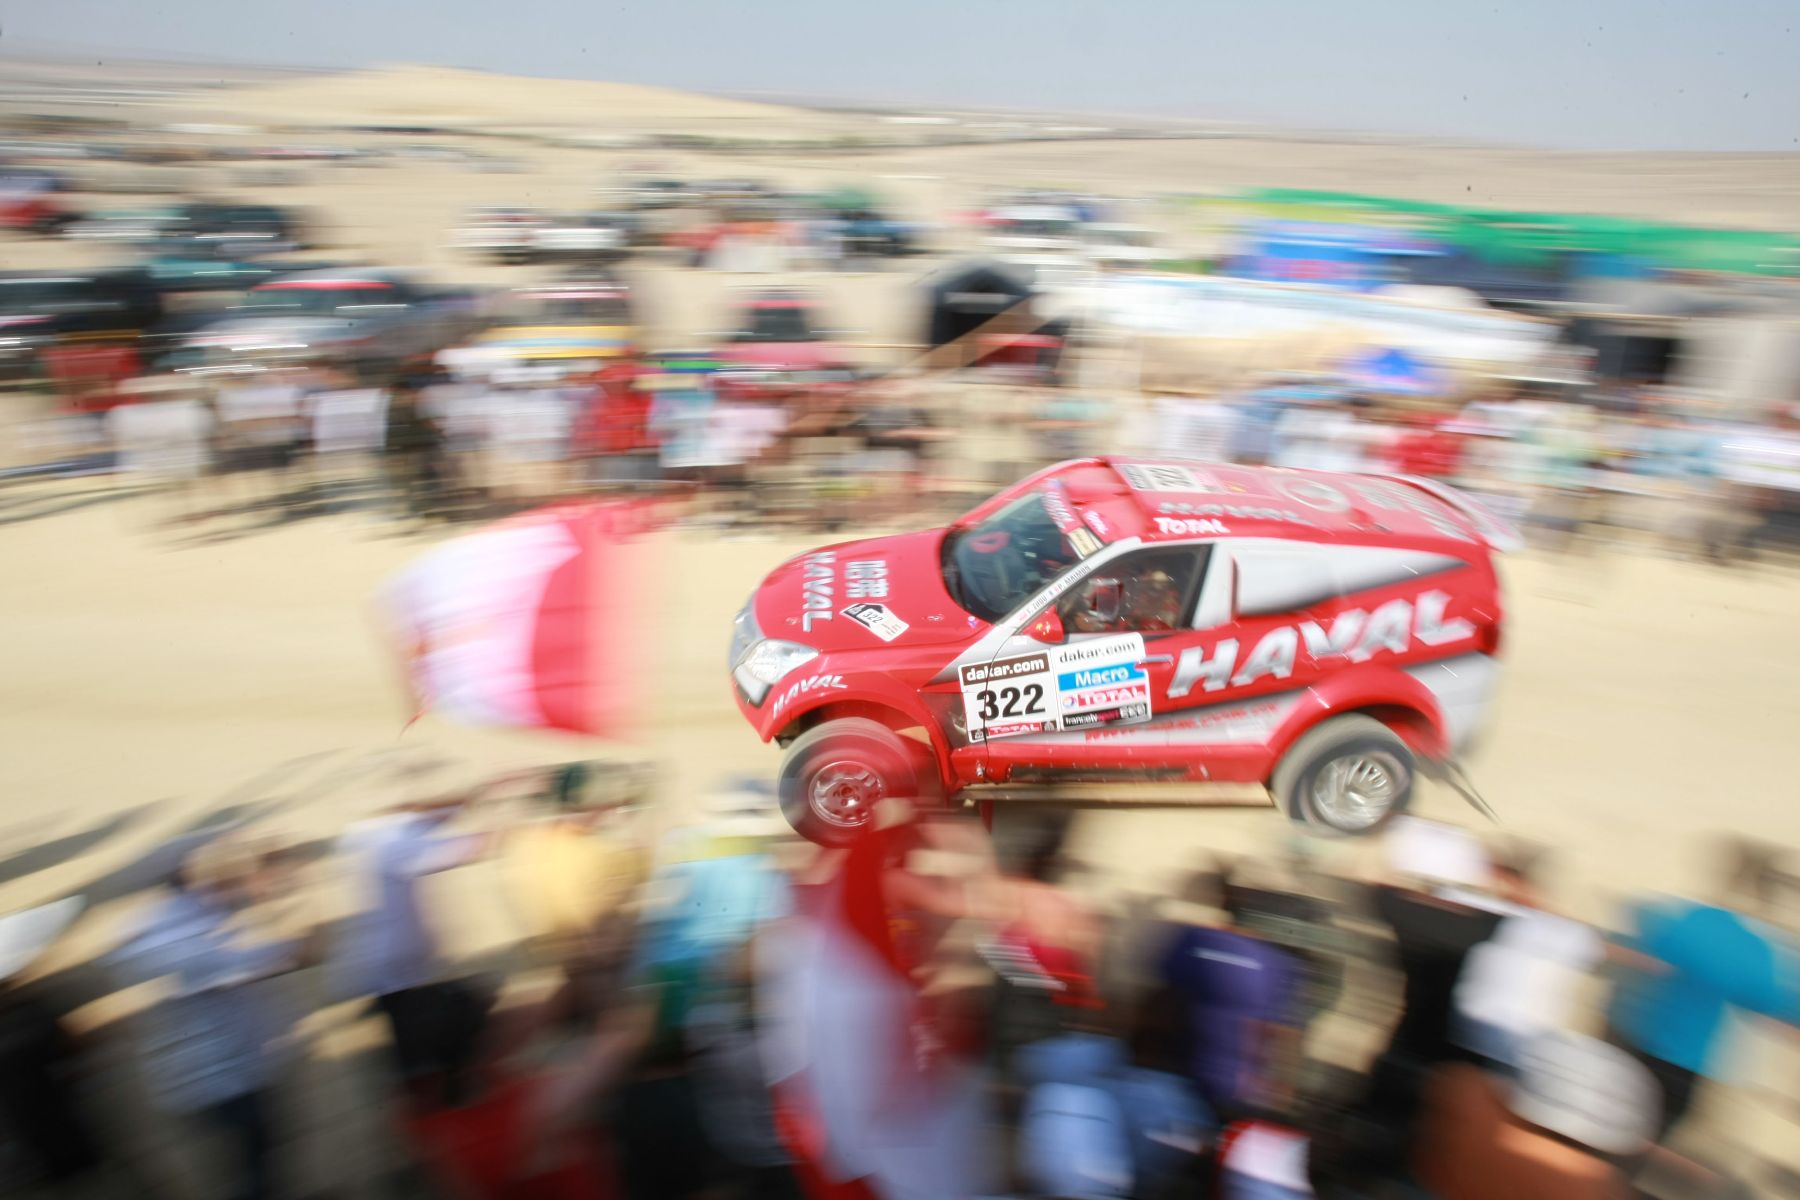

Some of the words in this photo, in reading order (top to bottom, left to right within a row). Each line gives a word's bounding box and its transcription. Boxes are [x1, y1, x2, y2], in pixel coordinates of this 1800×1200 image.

[1153, 517, 1231, 535] TOTAL
[803, 551, 837, 632] HAVAL
[862, 611, 883, 624] 322
[1059, 642, 1136, 664] dakar.com
[1168, 590, 1475, 698] HAVAL
[966, 658, 1045, 681] dakar.com
[1074, 667, 1129, 688] Macro
[773, 674, 848, 720] HAVAL
[976, 683, 1046, 721] 322
[1079, 688, 1146, 706] TOTAL
[989, 724, 1040, 735] TOTAL
